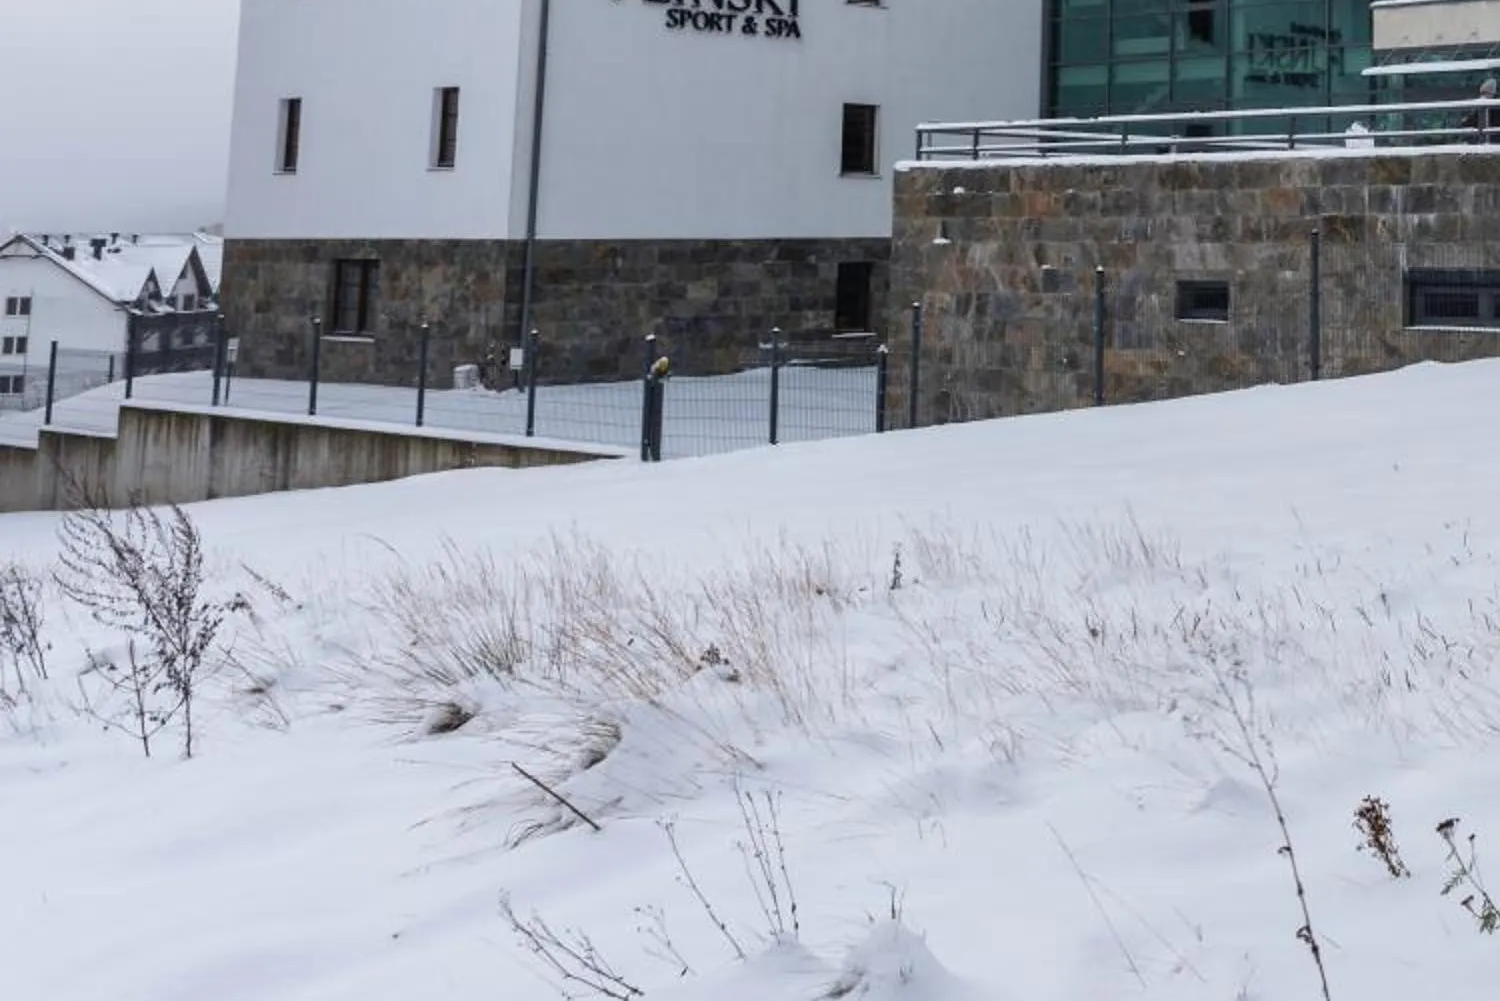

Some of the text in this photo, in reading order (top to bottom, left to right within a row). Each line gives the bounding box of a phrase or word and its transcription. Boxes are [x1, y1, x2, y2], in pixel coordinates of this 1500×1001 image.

[666, 8, 801, 39] SPORT & SPA
